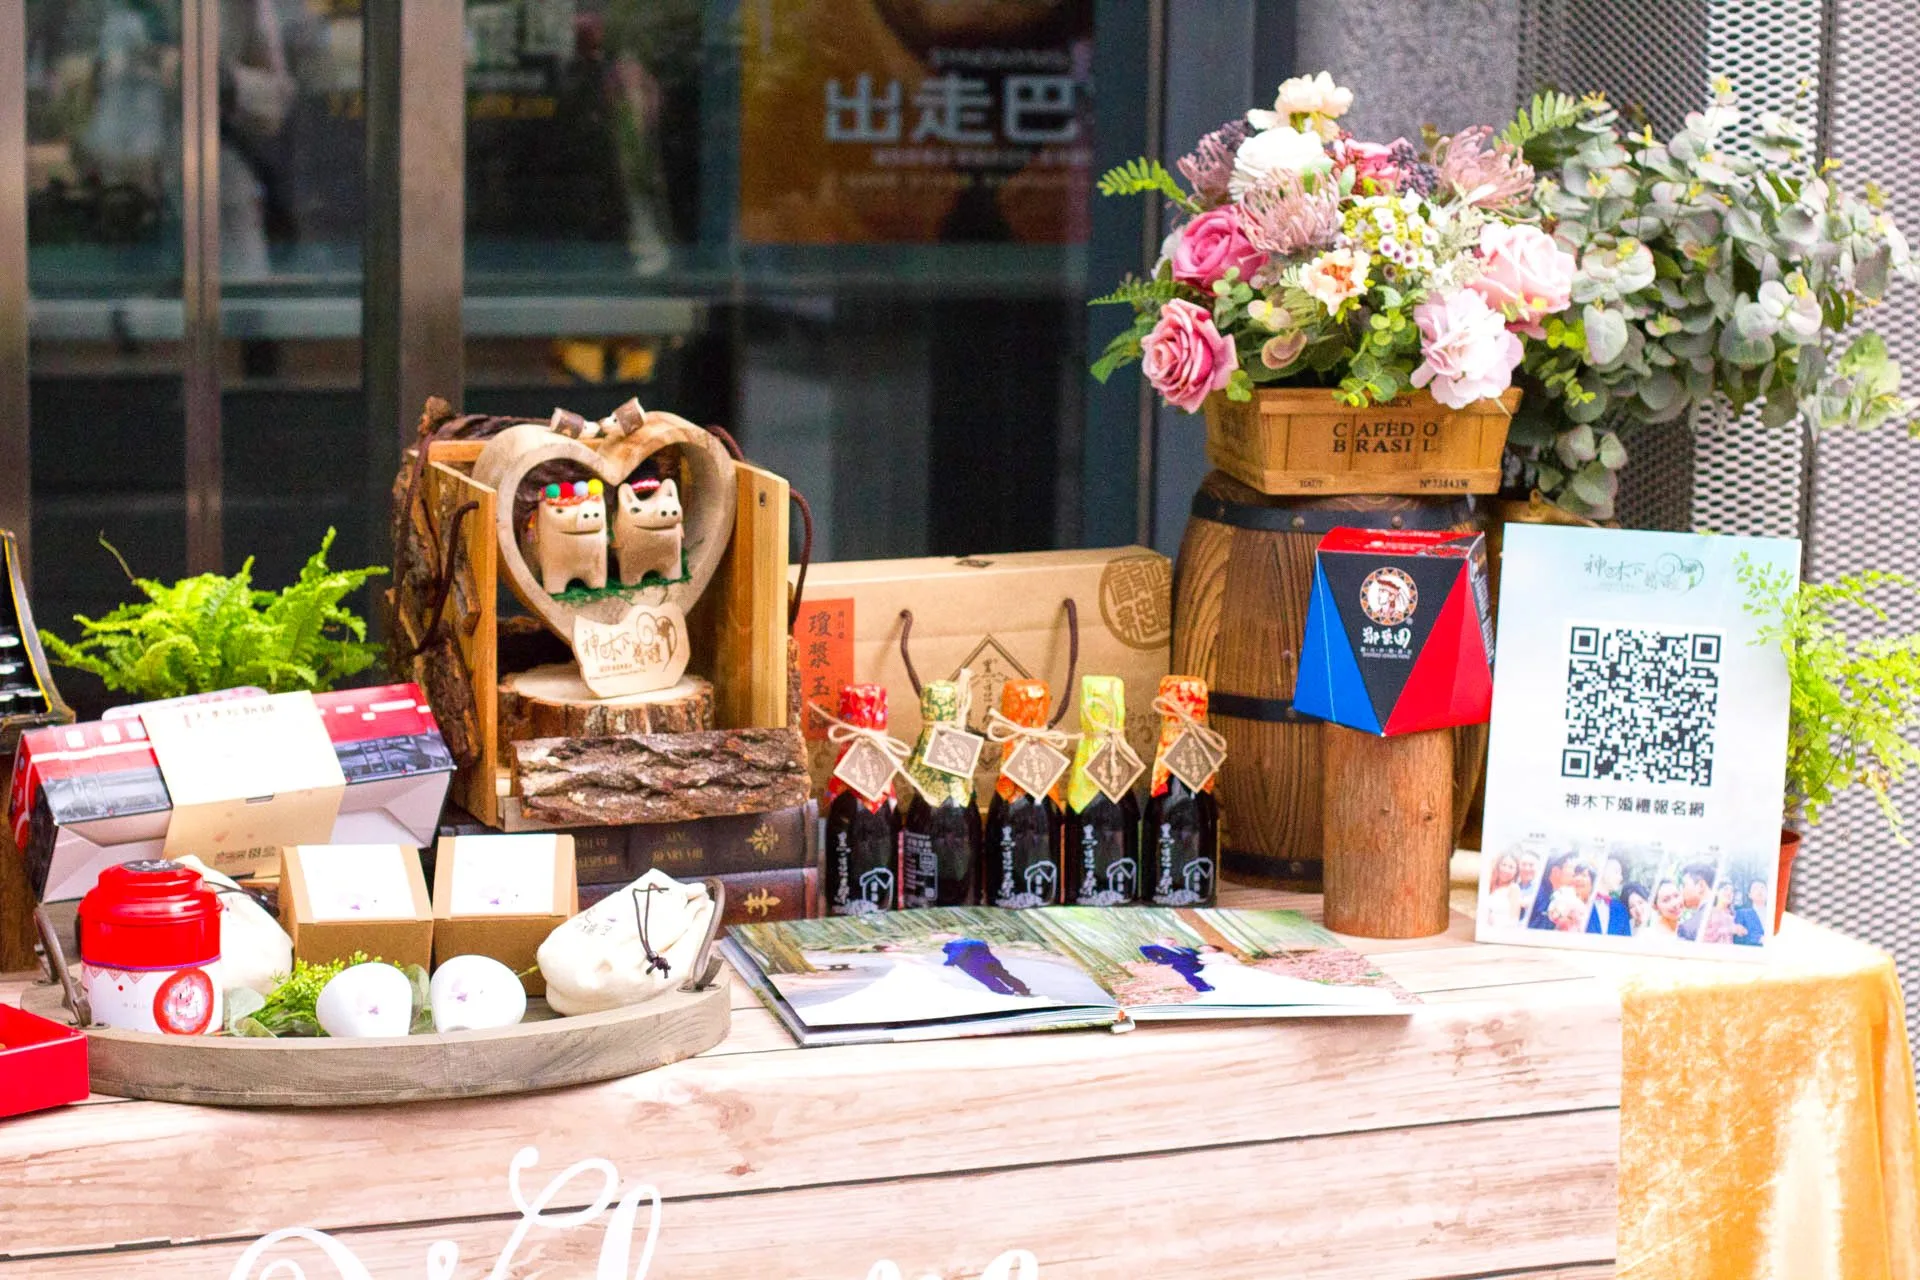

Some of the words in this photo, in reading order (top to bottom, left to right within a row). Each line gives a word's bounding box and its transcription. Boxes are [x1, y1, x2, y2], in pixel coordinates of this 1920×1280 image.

[825, 72, 1079, 143] 出走巴
[1565, 793, 1706, 819] 神木下婚禮報名網
